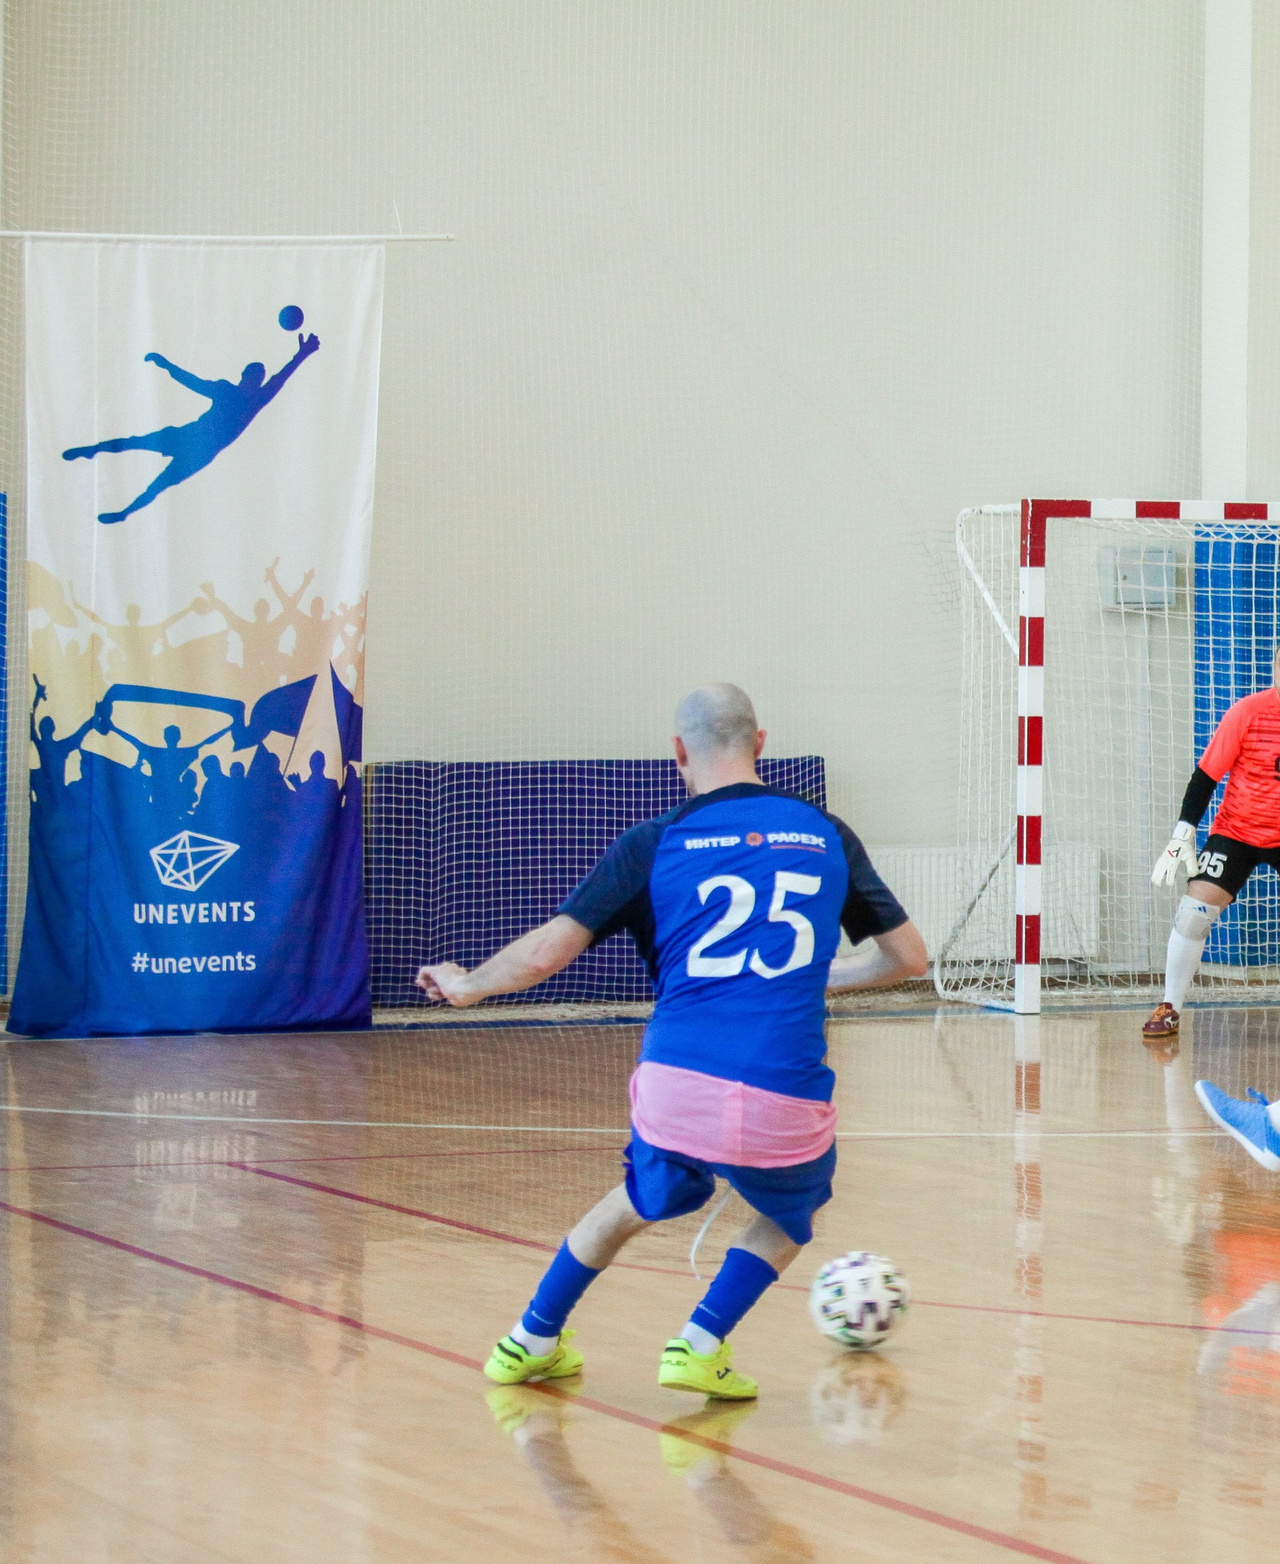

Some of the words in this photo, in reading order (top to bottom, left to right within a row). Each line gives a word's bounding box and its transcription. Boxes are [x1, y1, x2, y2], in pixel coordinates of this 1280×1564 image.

[685, 836, 741, 850] ИНТЕР
[1197, 851, 1228, 878] 95
[133, 900, 256, 925] UNEVENTS
[686, 871, 822, 980] 25
[131, 950, 257, 974] #unevents
